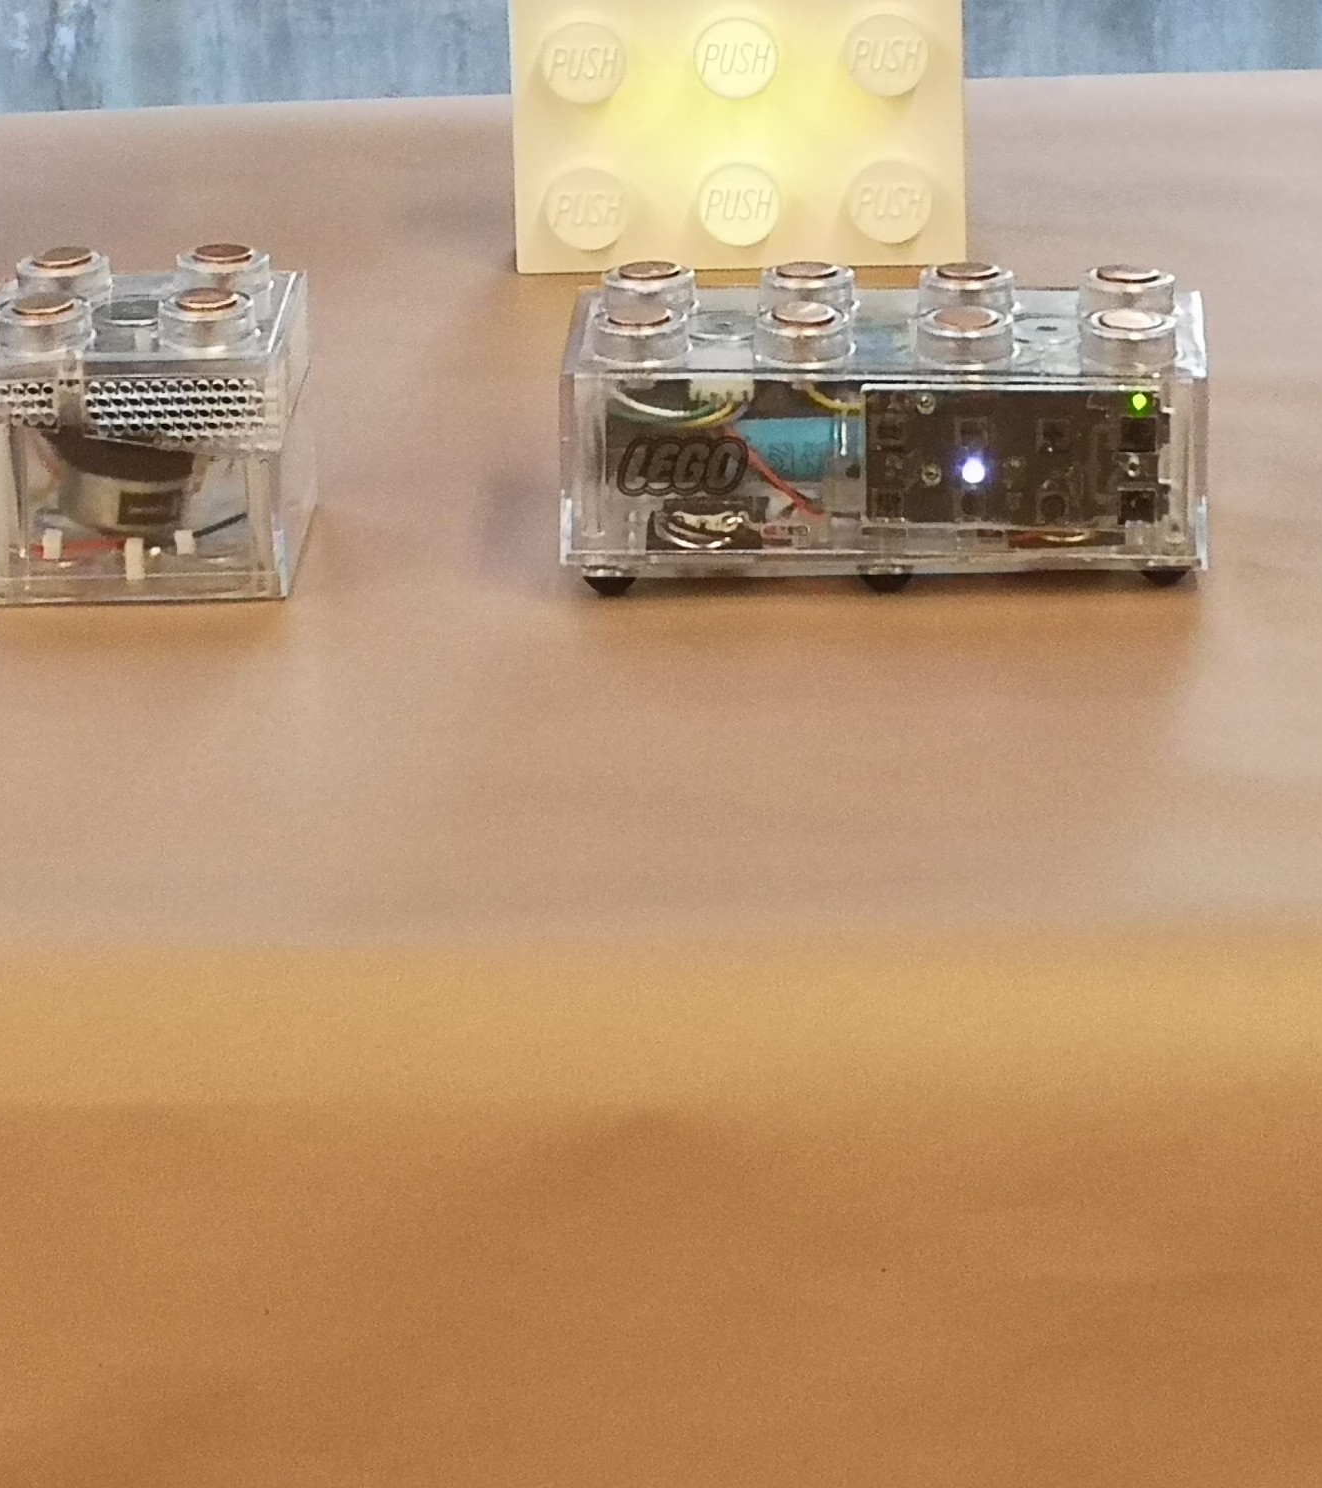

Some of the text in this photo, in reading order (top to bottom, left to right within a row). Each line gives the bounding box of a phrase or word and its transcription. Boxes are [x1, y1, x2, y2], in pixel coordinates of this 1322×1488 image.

[547, 46, 620, 82] PUSH
[701, 43, 770, 76] PUSH
[850, 39, 922, 73] PUSH
[552, 193, 624, 229] PUSH
[704, 189, 774, 221] PUSH
[855, 185, 924, 220] PUSH
[617, 436, 748, 496] LEGO
